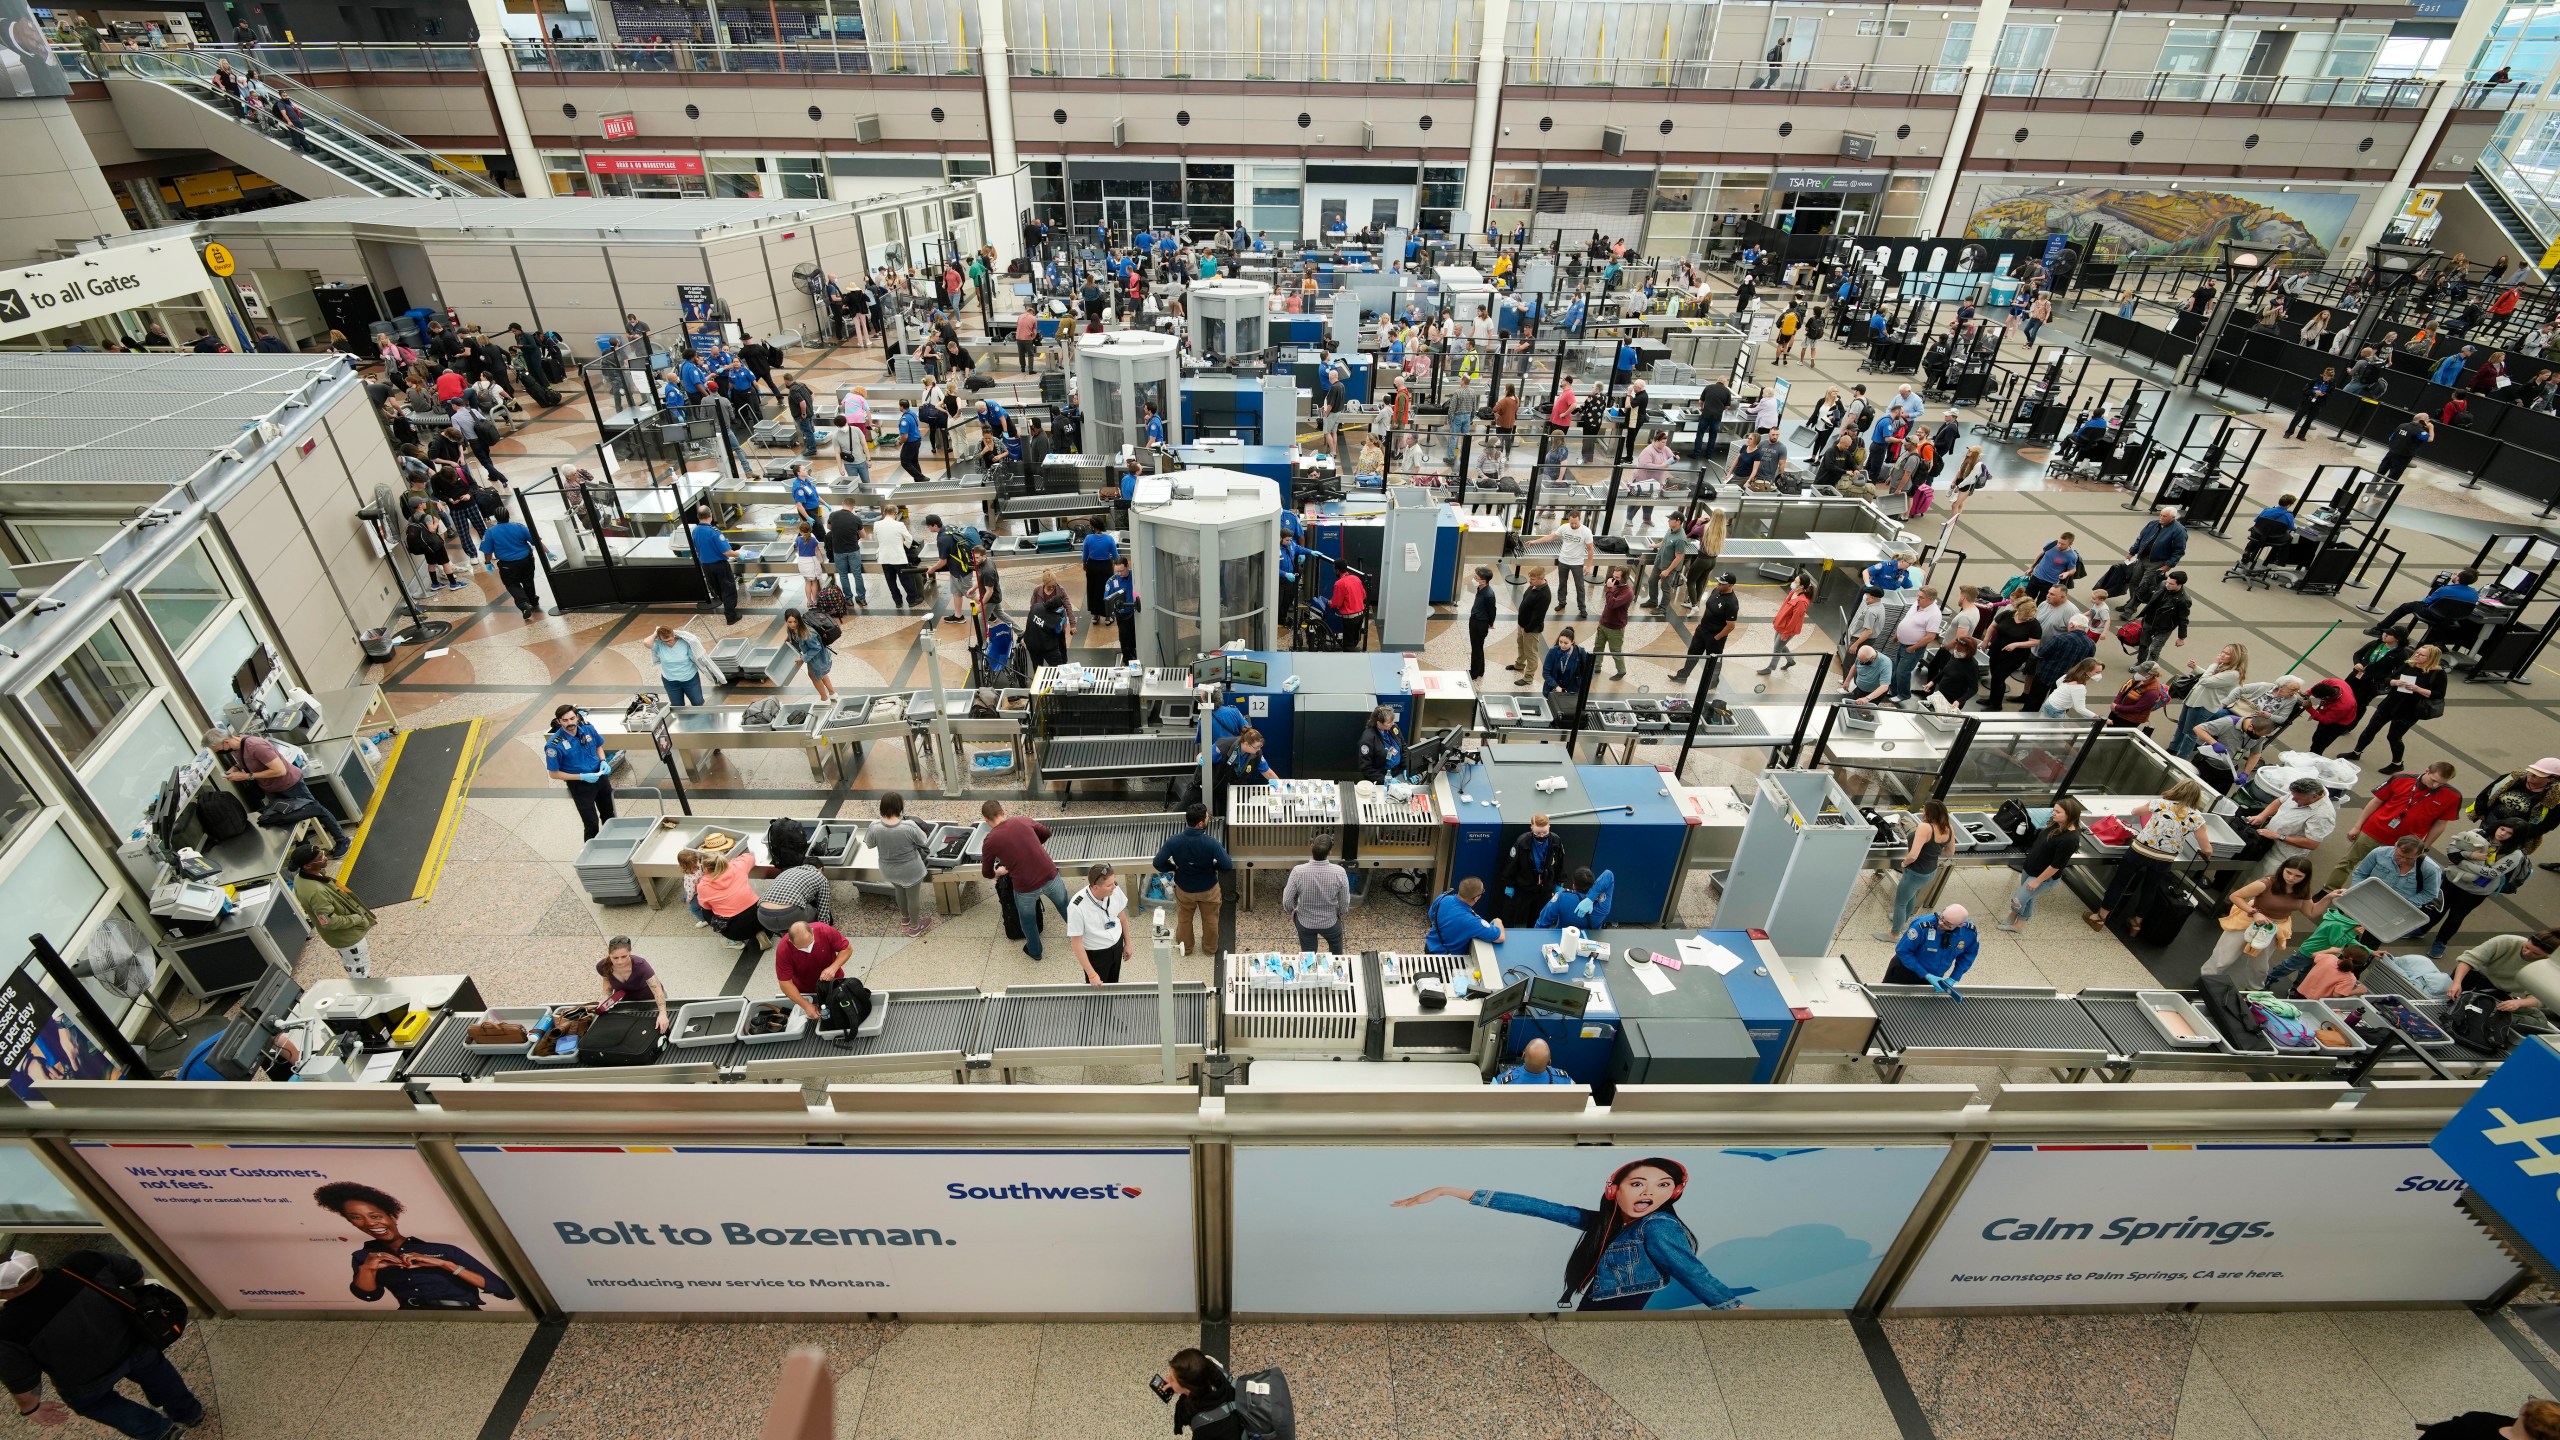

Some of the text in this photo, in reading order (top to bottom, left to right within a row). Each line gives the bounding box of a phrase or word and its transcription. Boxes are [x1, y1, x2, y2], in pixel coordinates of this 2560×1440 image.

[2418, 4, 2440, 12] East
[1790, 178, 1821, 188] TSA Pre
[30, 274, 140, 309] to all Gates
[1032, 615, 1045, 628] TSA
[1252, 701, 1265, 710] 12
[4, 1022, 20, 1044] per
[18, 1002, 35, 1024] day
[4, 1020, 36, 1066] enough?
[124, 1167, 328, 1179] We love our Customers,
[139, 1180, 213, 1189] not fees.
[946, 1182, 1120, 1199] Southwest
[2395, 1176, 2466, 1192] Sout
[552, 1221, 958, 1246] Bolt to Bozeman.
[1982, 1215, 2275, 1246] Calm Springs.
[1951, 1273, 1986, 1282] New
[1989, 1272, 2063, 1283] nonstops
[2065, 1272, 2082, 1281] to
[2085, 1271, 2124, 1280] Palm
[2126, 1270, 2189, 1282] Springs,
[2192, 1271, 2215, 1279] CA
[2246, 1270, 2285, 1279] here.
[587, 1278, 890, 1289] Introducing new service to Montana.
